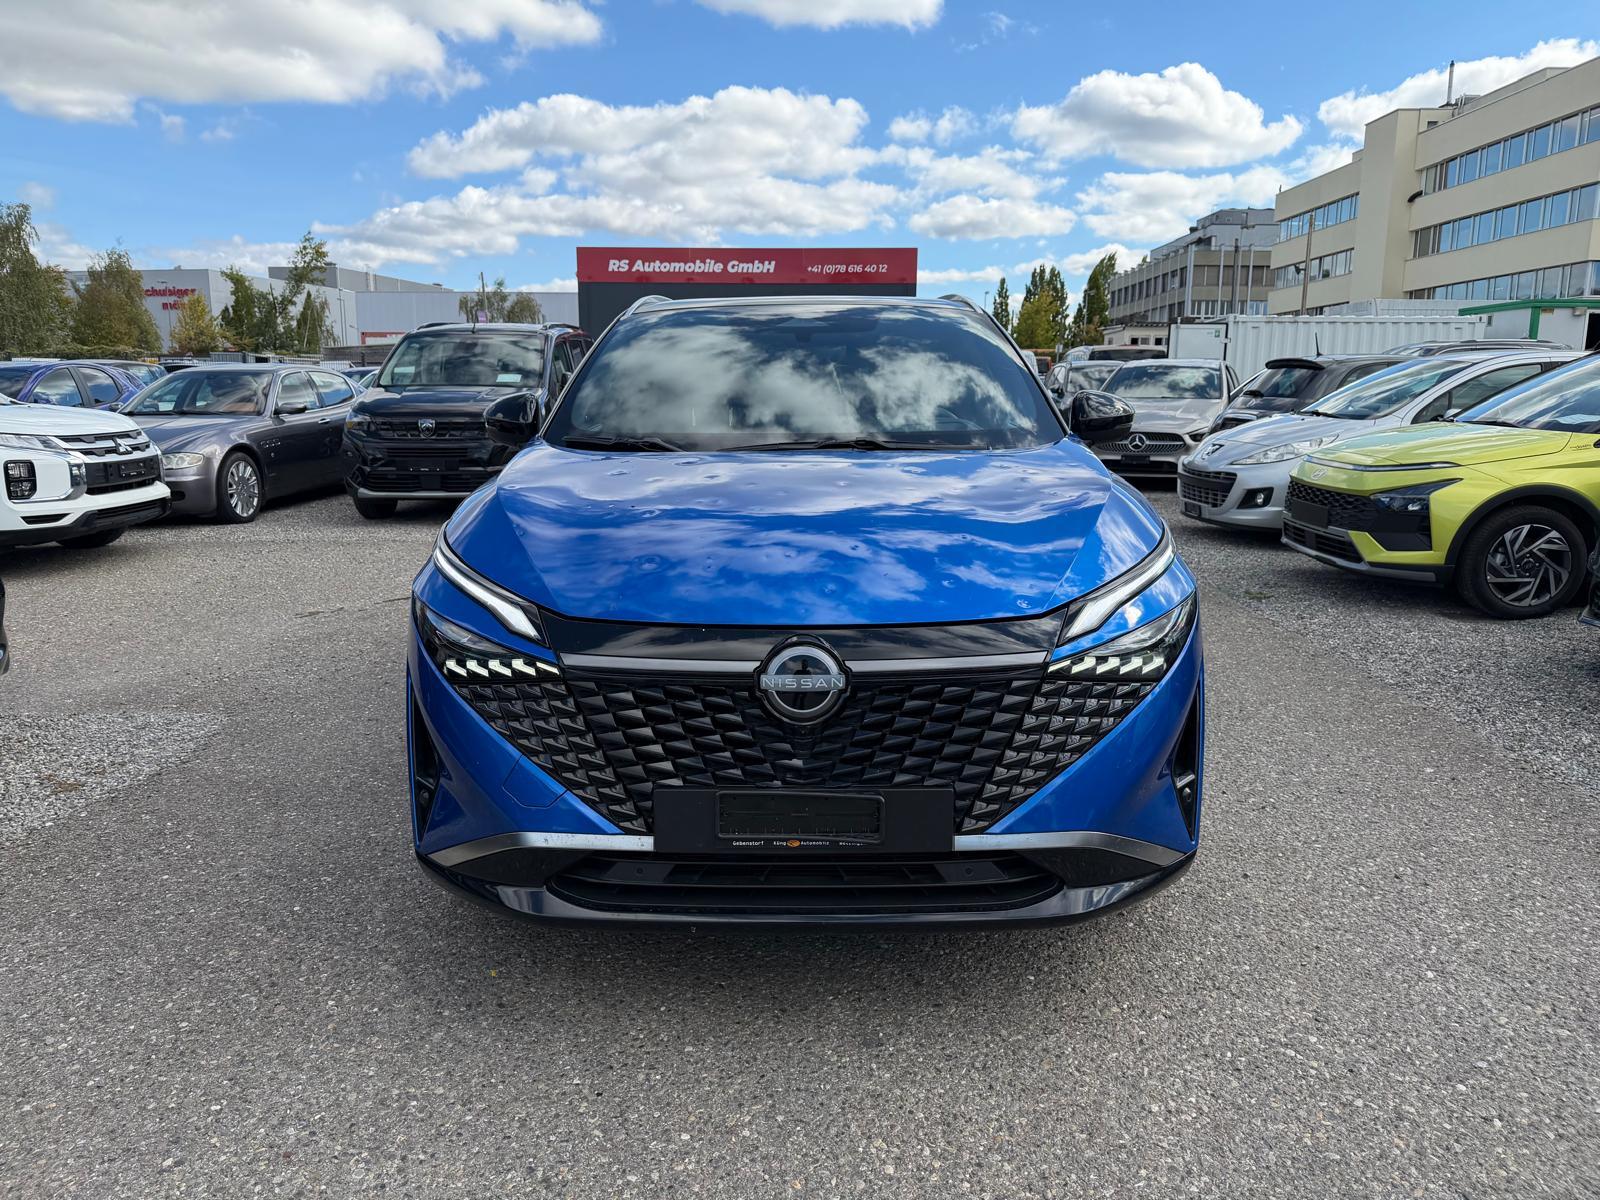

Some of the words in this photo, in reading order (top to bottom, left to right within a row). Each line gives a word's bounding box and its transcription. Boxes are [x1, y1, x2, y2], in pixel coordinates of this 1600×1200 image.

[608, 259, 629, 272] RS
[632, 259, 724, 272] Automobile
[727, 259, 776, 273] GmbH
[807, 264, 822, 273] +41
[823, 264, 846, 275] (0)78
[848, 264, 863, 273] 616
[864, 264, 877, 273] 40
[879, 264, 888, 273] 12
[144, 286, 197, 299] chubiger
[762, 677, 843, 688] NISSAN
